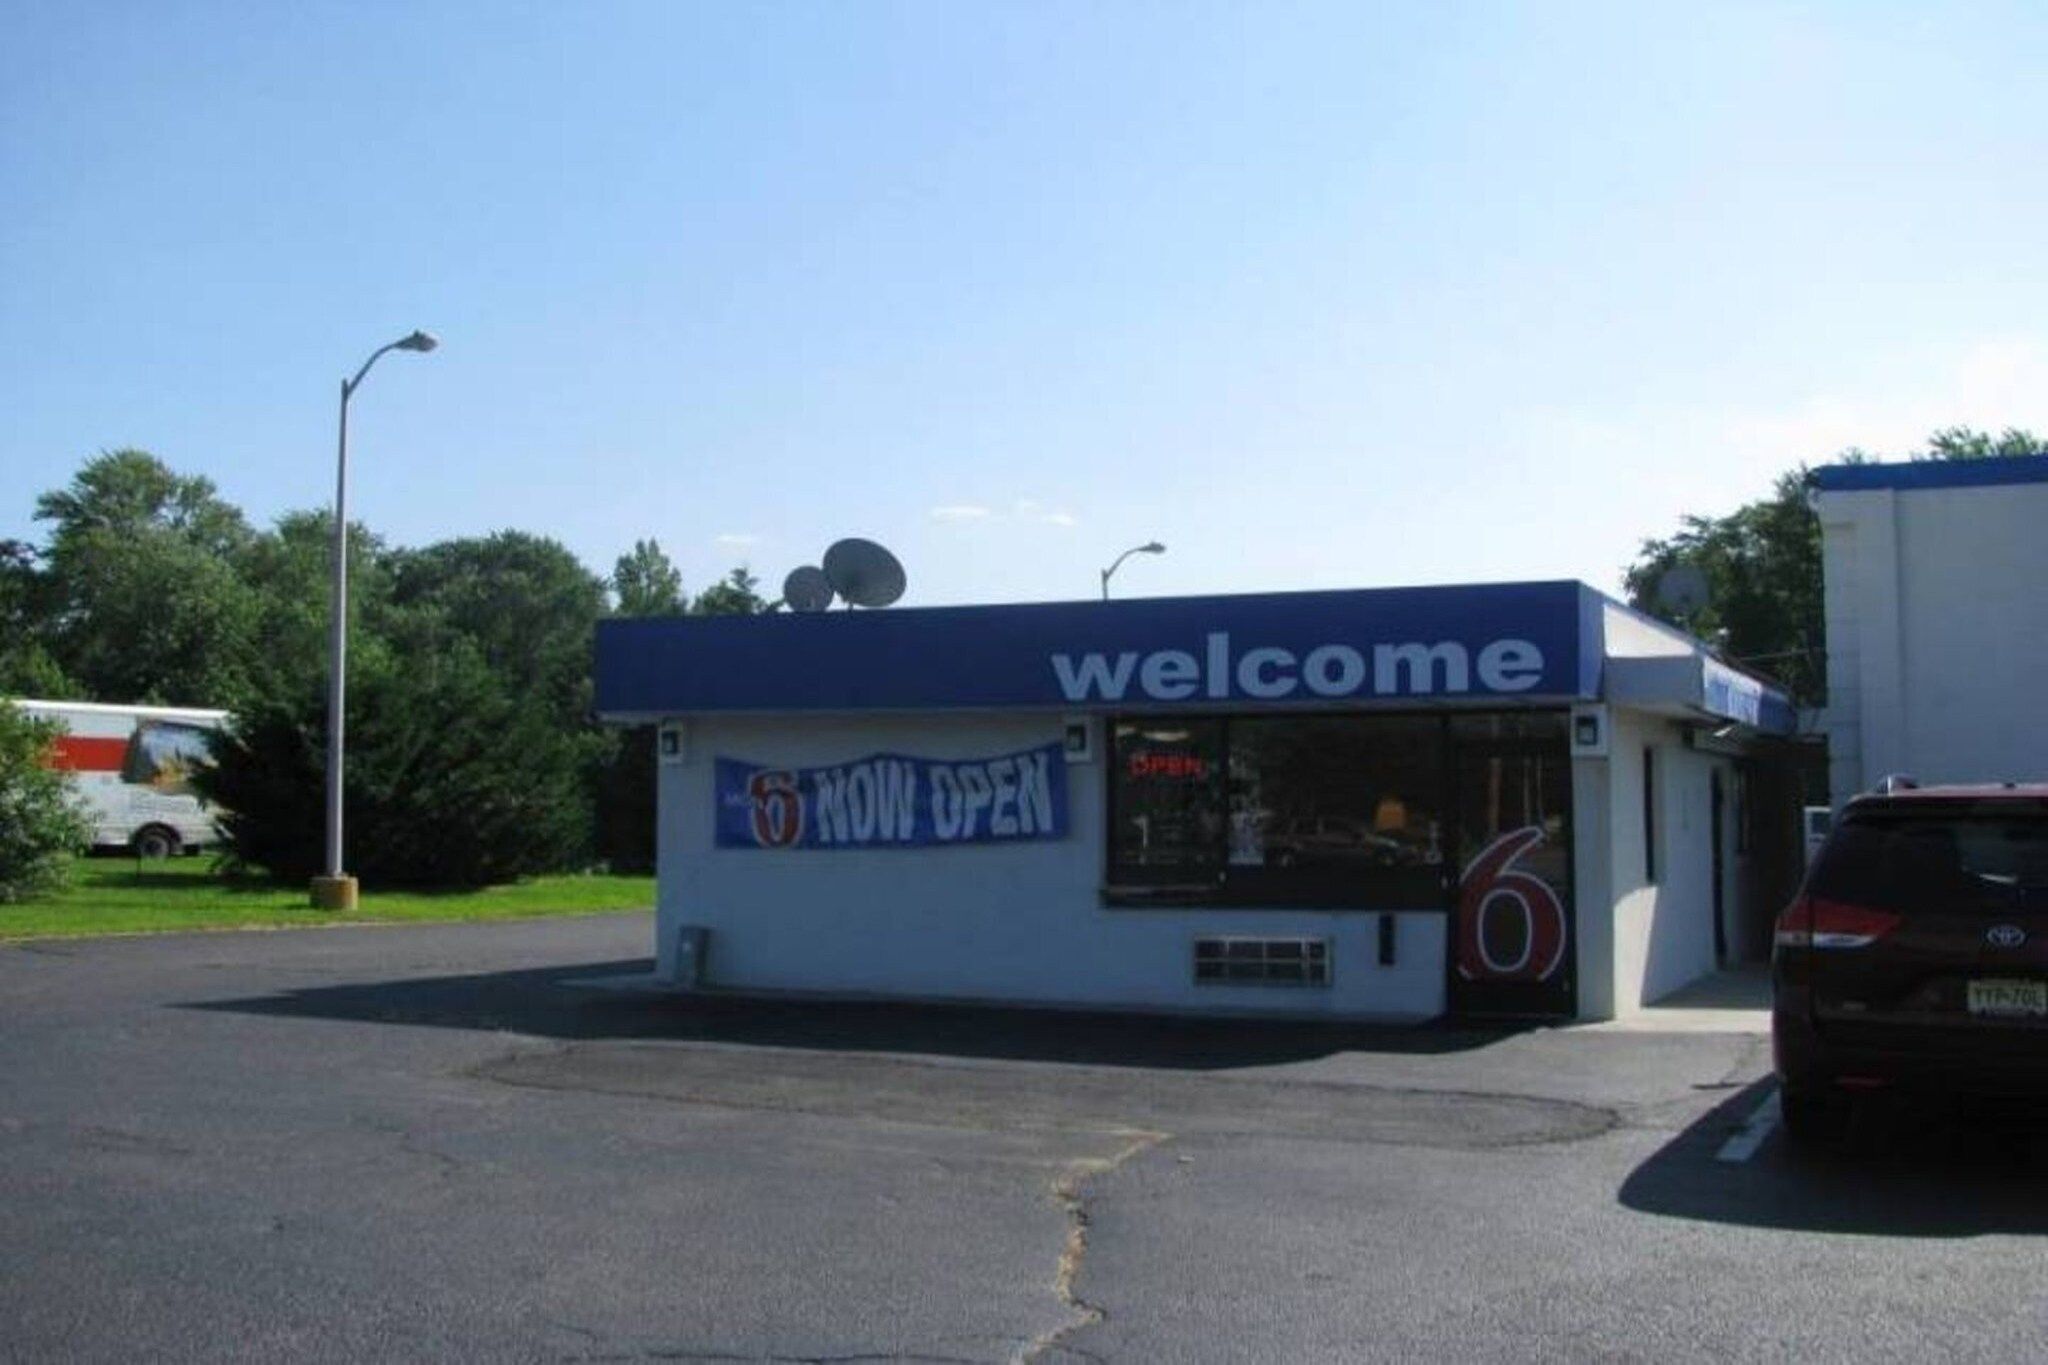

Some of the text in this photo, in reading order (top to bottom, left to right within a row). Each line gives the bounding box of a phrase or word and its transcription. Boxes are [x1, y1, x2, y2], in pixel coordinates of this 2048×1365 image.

[1051, 631, 1545, 701] welcome
[814, 758, 916, 842] NOW
[931, 752, 1051, 839] OPEN
[1457, 826, 1566, 981] 6
